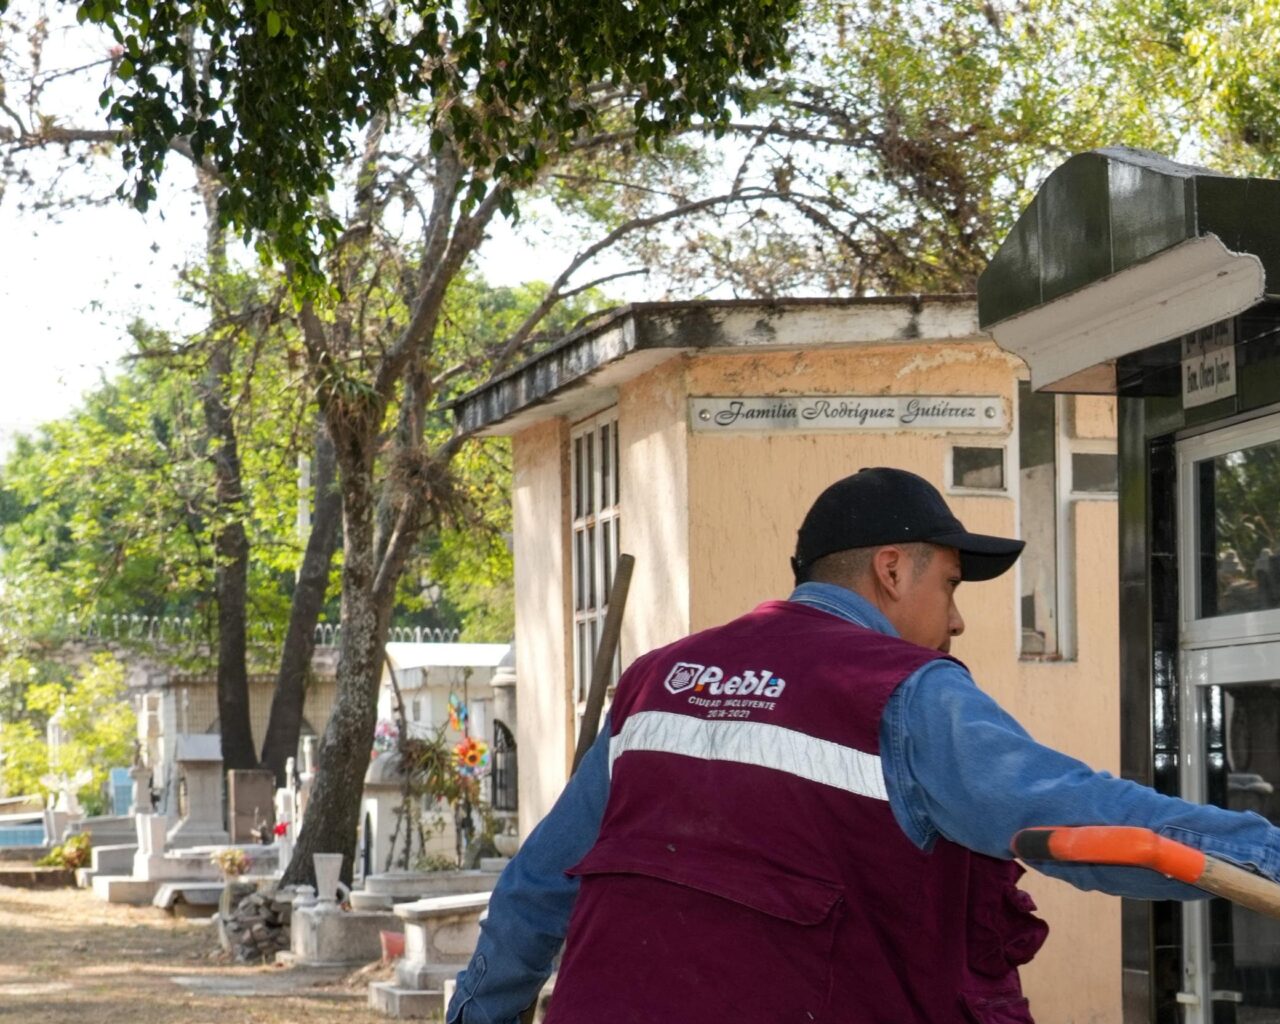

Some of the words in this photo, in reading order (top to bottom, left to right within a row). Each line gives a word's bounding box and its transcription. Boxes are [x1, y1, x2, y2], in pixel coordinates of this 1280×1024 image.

[714, 401, 797, 426] Familia
[801, 400, 895, 425] Rodríguez
[899, 399, 976, 424] Gutiérrez
[694, 666, 786, 698] Puebla
[688, 696, 722, 708] CIUDAD
[723, 698, 777, 711] INCLUYENTE
